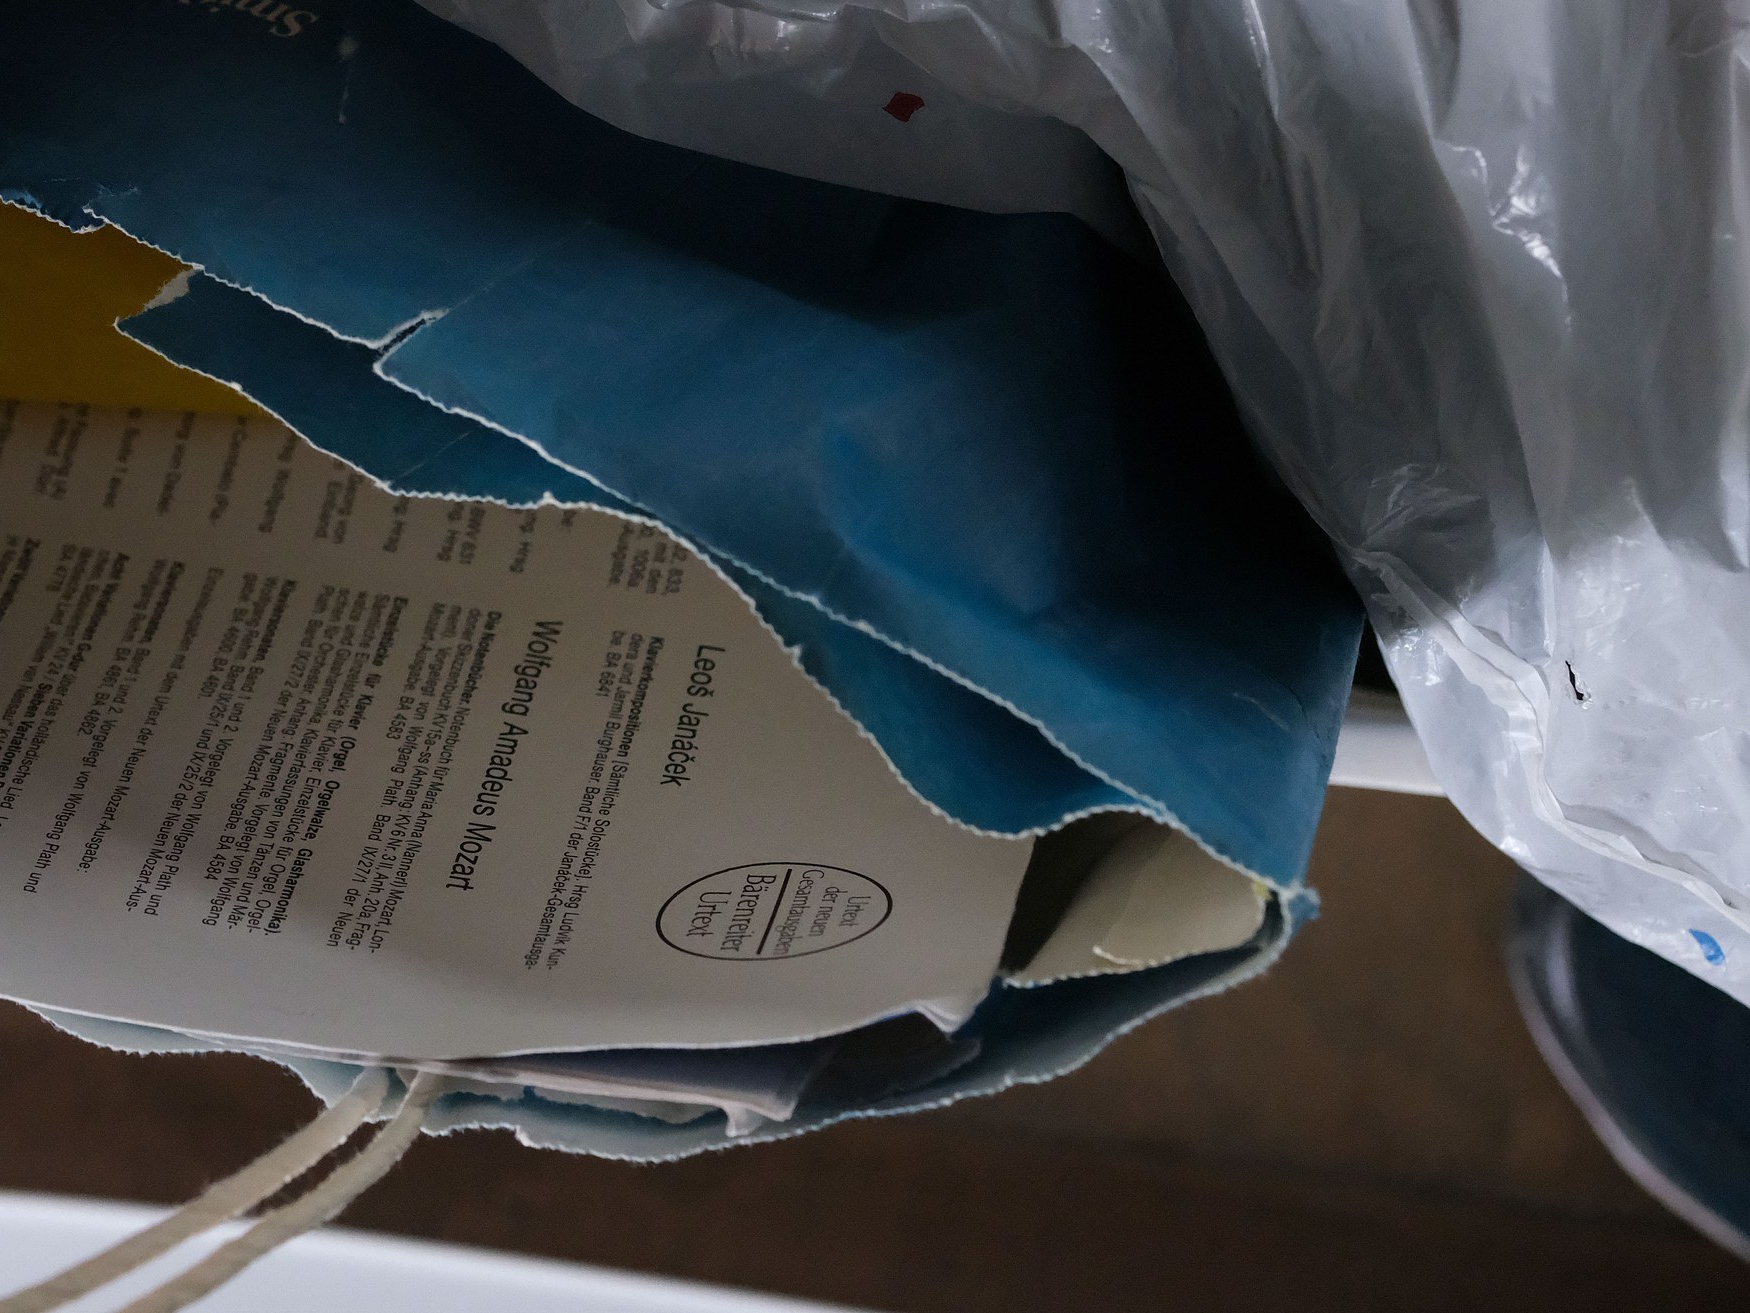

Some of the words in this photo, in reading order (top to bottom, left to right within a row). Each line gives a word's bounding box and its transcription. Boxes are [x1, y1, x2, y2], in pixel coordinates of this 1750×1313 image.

[501, 613, 565, 721] Wolfgang
[594, 669, 615, 699] 6841
[685, 641, 726, 701] Leoš
[613, 634, 664, 759] Klavierkompositionen
[118, 746, 146, 784] Neuen
[196, 734, 233, 789] Vorgelegt
[327, 734, 356, 775] (Orgel,
[390, 723, 423, 776] Wolfgang
[584, 719, 620, 785] Burghauser.
[660, 701, 709, 792] Janáček
[220, 741, 272, 834] Mozart-Ausgabe.
[255, 739, 294, 801] Fragmente.
[268, 726, 319, 820] Klavierfassungen
[396, 762, 428, 814] (Anhang:
[471, 720, 529, 821] Amadeus
[0, 785, 22, 810] Lied
[282, 775, 320, 844] Einzelstücke
[300, 777, 339, 844] Orgelwalze,
[380, 777, 403, 810] Plath.
[421, 780, 443, 812] Maria
[578, 784, 599, 815] Band
[45, 789, 84, 842] Wolfgang
[72, 783, 129, 875] Mozart-Ausgabe:
[153, 810, 180, 848] Neuen
[164, 809, 201, 863] Wolfgang
[232, 801, 269, 855] Vorgelegt
[368, 813, 390, 843] Band
[410, 810, 432, 839] Anna
[34, 842, 59, 870] Plath
[202, 851, 226, 881] 4584
[245, 838, 274, 881] Tänzen
[351, 845, 378, 884] IX/27/1
[389, 837, 421, 889] (Nannerl)
[445, 818, 495, 896] Mozart
[123, 847, 164, 913] Mozart-Aus-
[155, 863, 178, 893] Plath
[235, 879, 257, 904] und
[256, 860, 286, 898] Orgel,
[262, 845, 311, 939] Glasharmonika).
[367, 871, 388, 898] Anh.
[820, 884, 844, 906] der
[201, 874, 238, 928] Wolfgang
[224, 903, 247, 931] Mär-
[241, 896, 271, 934] Orgel-
[356, 896, 378, 923] 20a,
[375, 887, 403, 930] Mozart,
[520, 849, 578, 972] Janáček-Gesamtausga-
[683, 884, 731, 943] Urtext
[718, 868, 777, 957] Bärenreiter
[766, 864, 825, 959] Gesamtausgaben
[806, 903, 831, 939] neuen
[837, 892, 870, 931] Urtext
[325, 910, 352, 949] Neuen
[344, 919, 369, 952] Frag-
[553, 909, 578, 948] Ludvik
